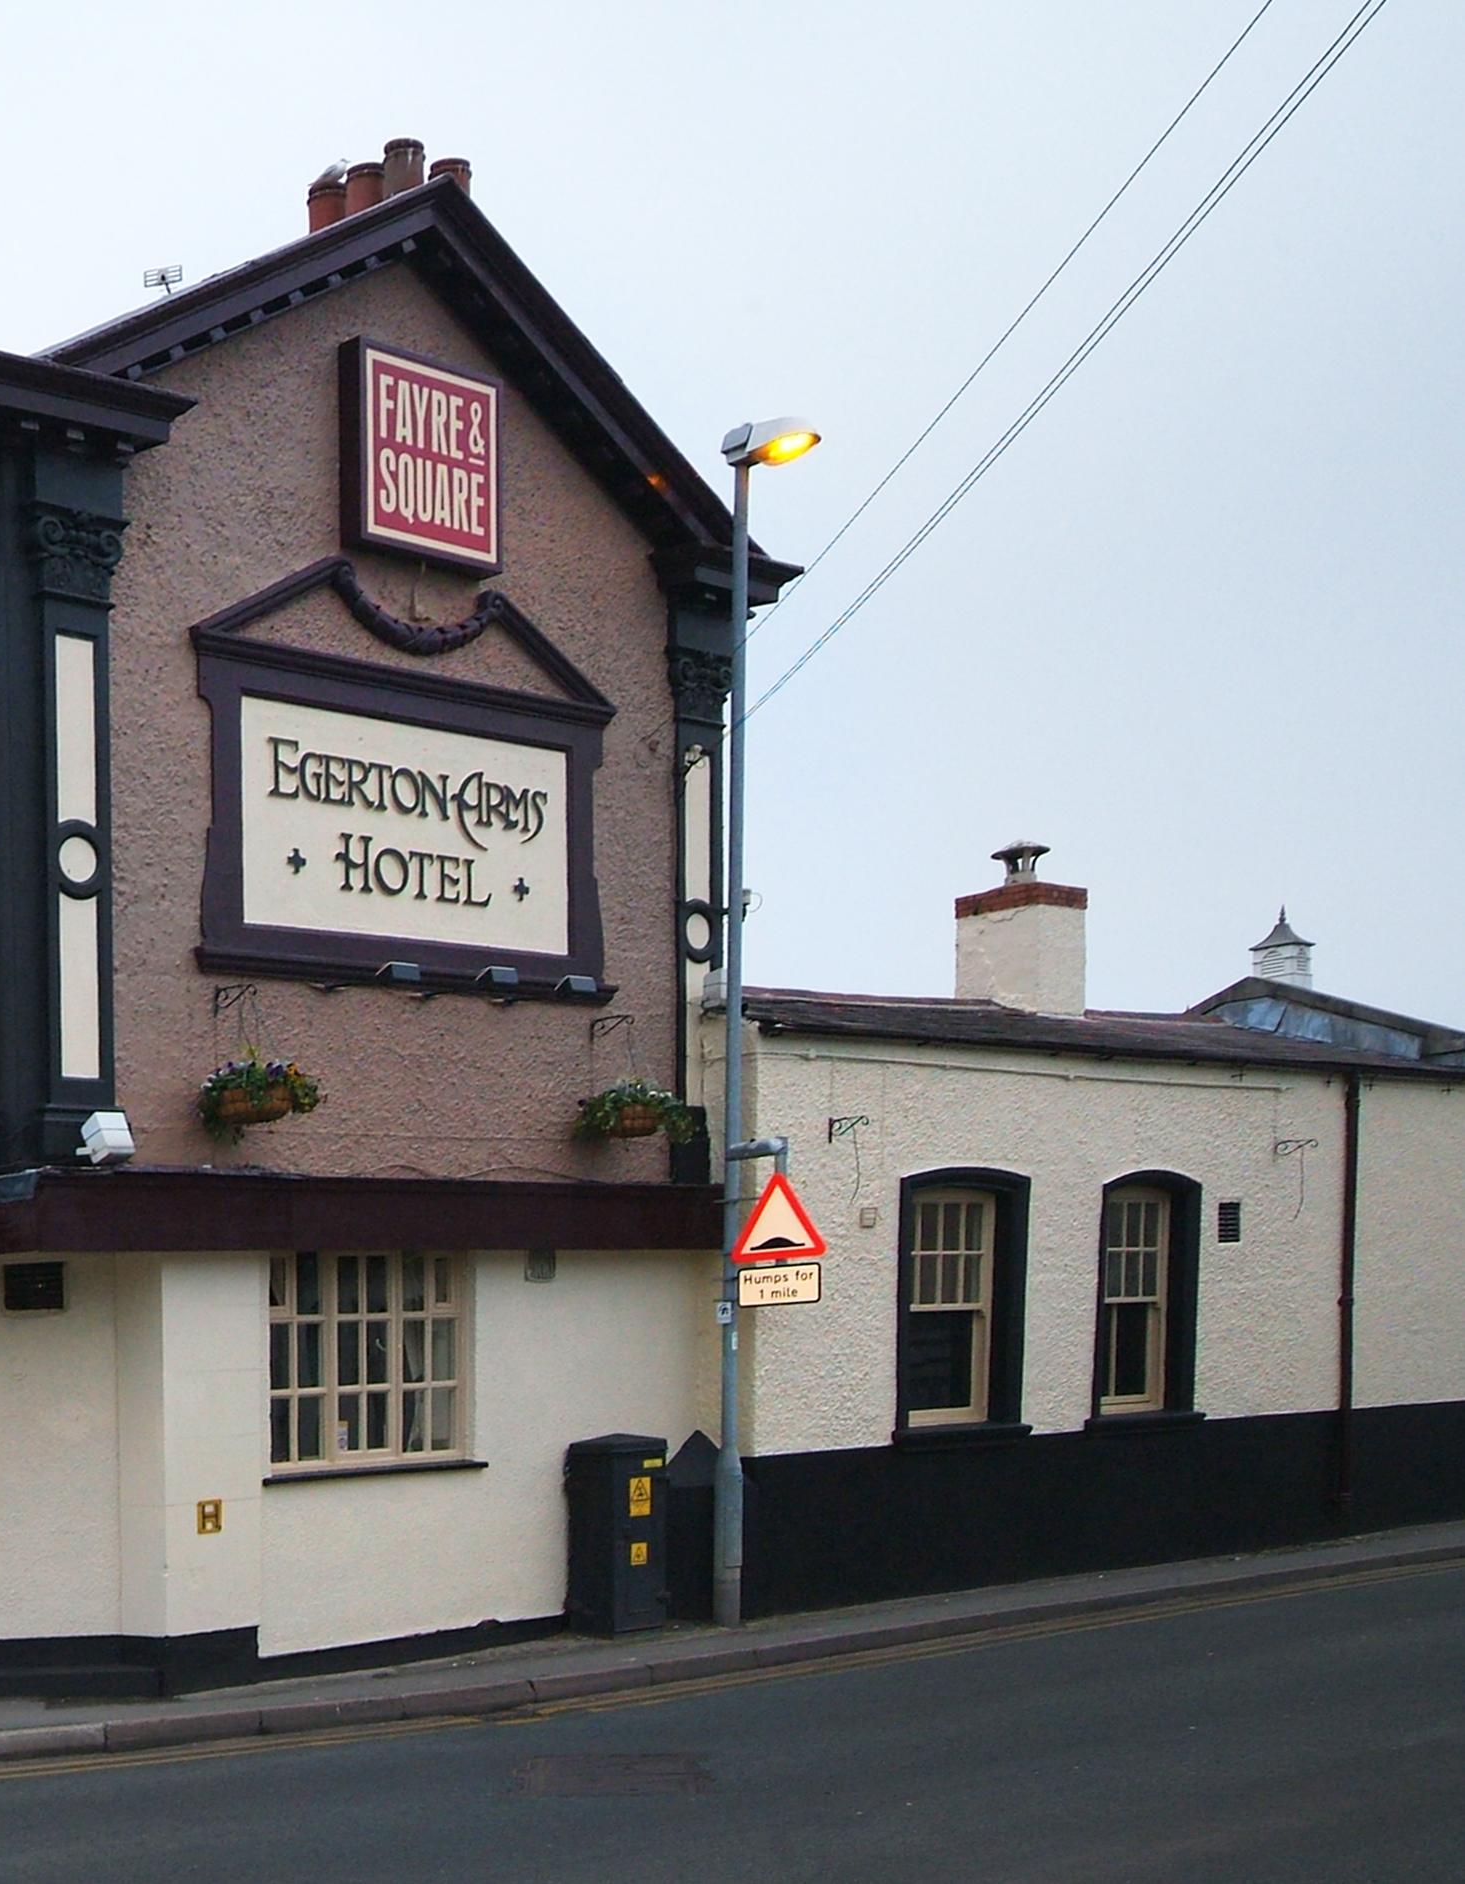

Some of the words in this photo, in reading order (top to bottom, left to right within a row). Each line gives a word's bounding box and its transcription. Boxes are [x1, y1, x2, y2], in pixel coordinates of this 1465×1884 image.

[379, 373, 464, 460] FAYRE
[468, 401, 485, 466] &
[379, 447, 485, 537] SQUARE
[267, 736, 451, 821] EGERTON
[449, 771, 548, 851] ARMS
[335, 832, 493, 908] HOTEL
[744, 1273, 789, 1284] Humps
[795, 1270, 813, 1281] for
[760, 1289, 764, 1299] 1
[770, 1287, 798, 1299] mile
